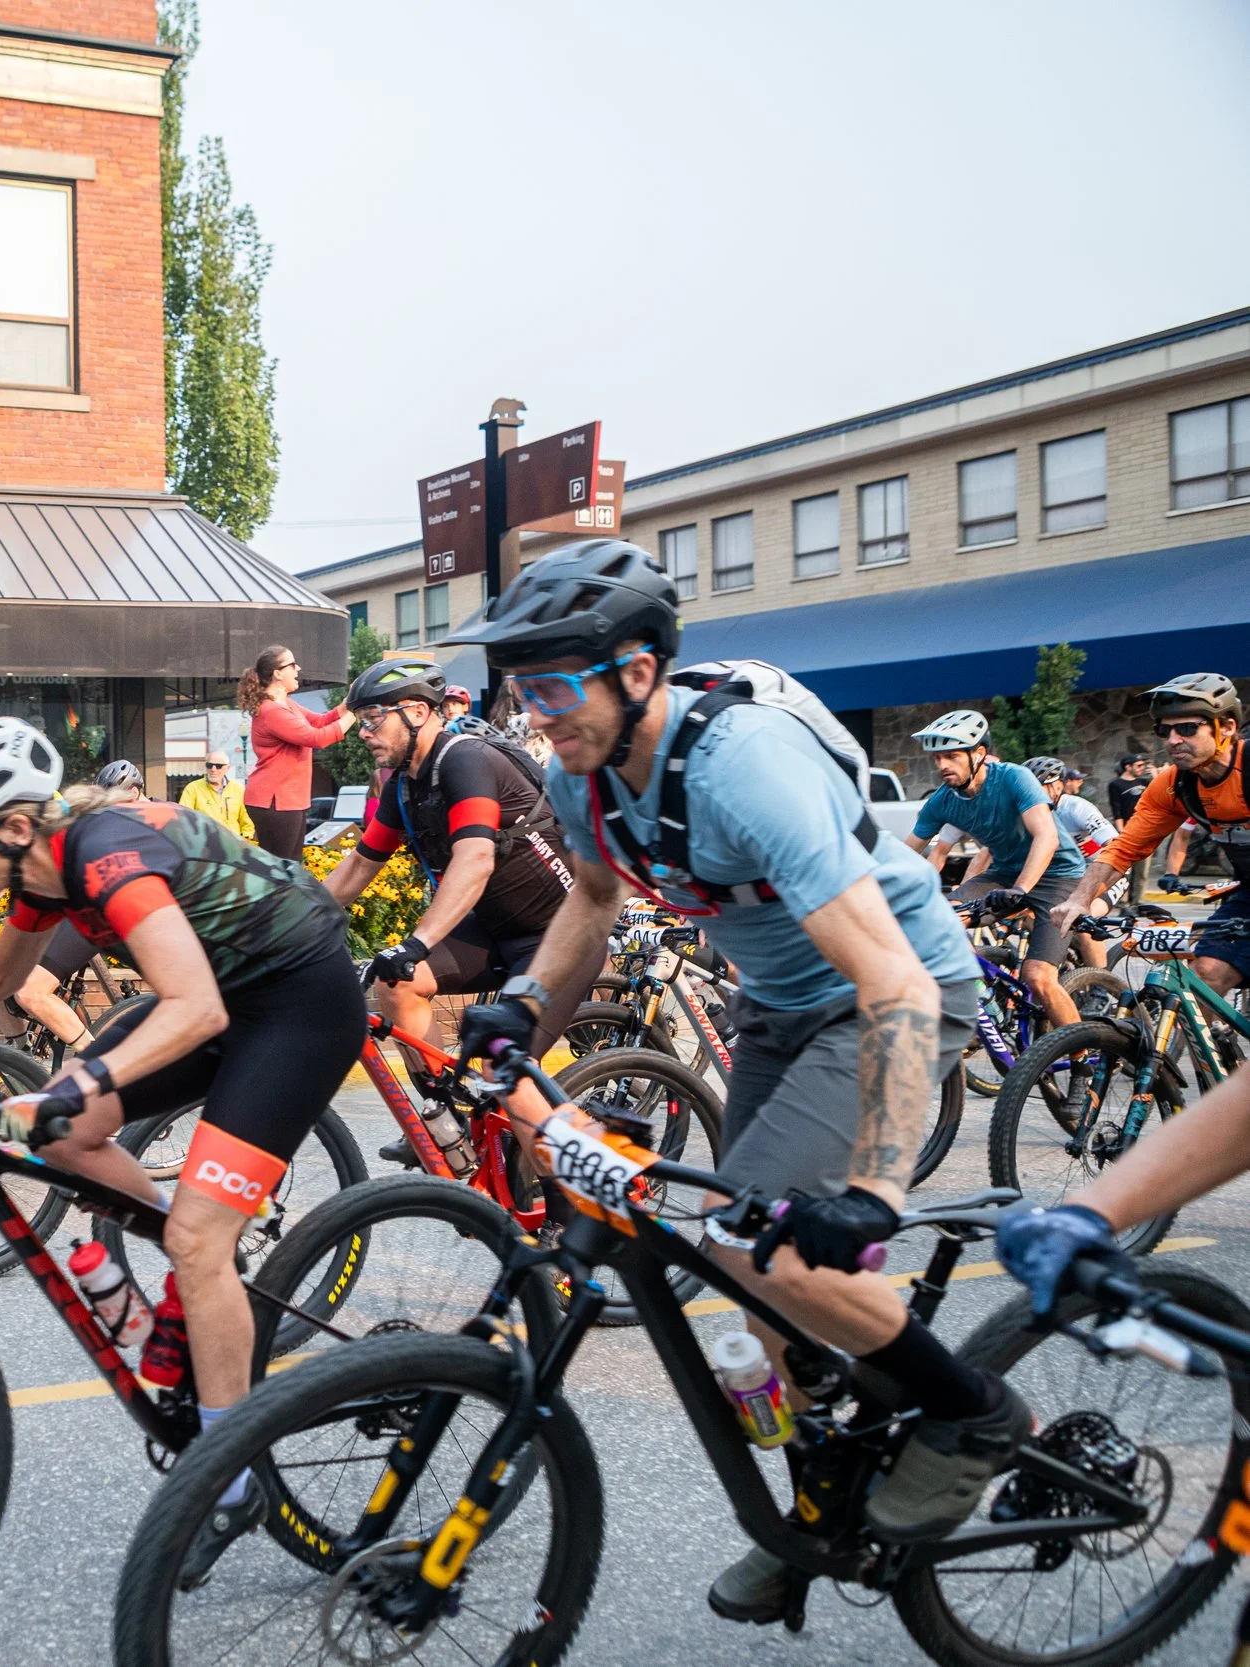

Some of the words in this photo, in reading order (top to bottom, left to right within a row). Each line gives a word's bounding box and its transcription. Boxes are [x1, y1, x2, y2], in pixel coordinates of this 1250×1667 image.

[562, 433, 586, 449] Parking
[685, 993, 719, 1044] SANTA
[365, 1055, 413, 1120] SANTA
[406, 1121, 445, 1168] CRUZ
[1, 1193, 145, 1405] TREK
[328, 1232, 362, 1305] MAXXIS
